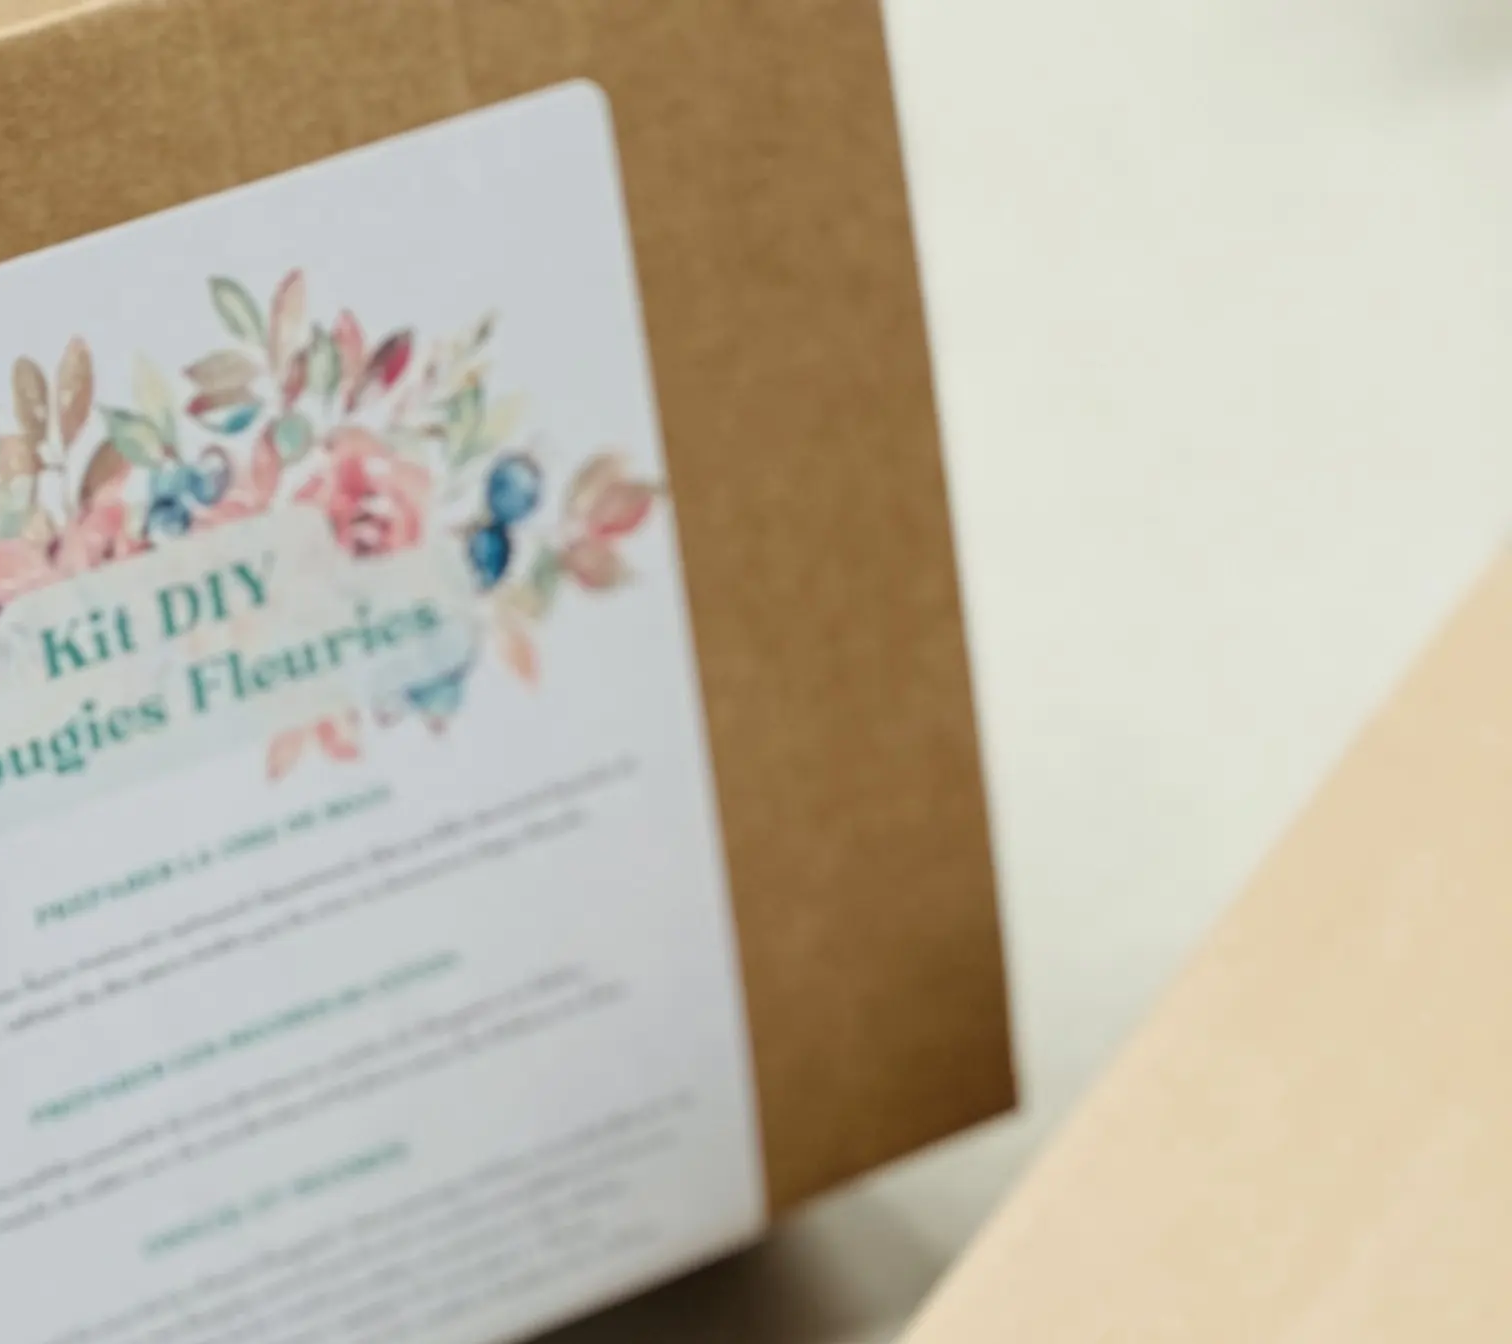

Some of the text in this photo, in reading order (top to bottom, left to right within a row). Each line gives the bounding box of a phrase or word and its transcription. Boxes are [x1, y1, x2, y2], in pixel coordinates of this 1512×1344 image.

[42, 552, 275, 679] Kit DIY
[187, 600, 437, 713] Fleuries
